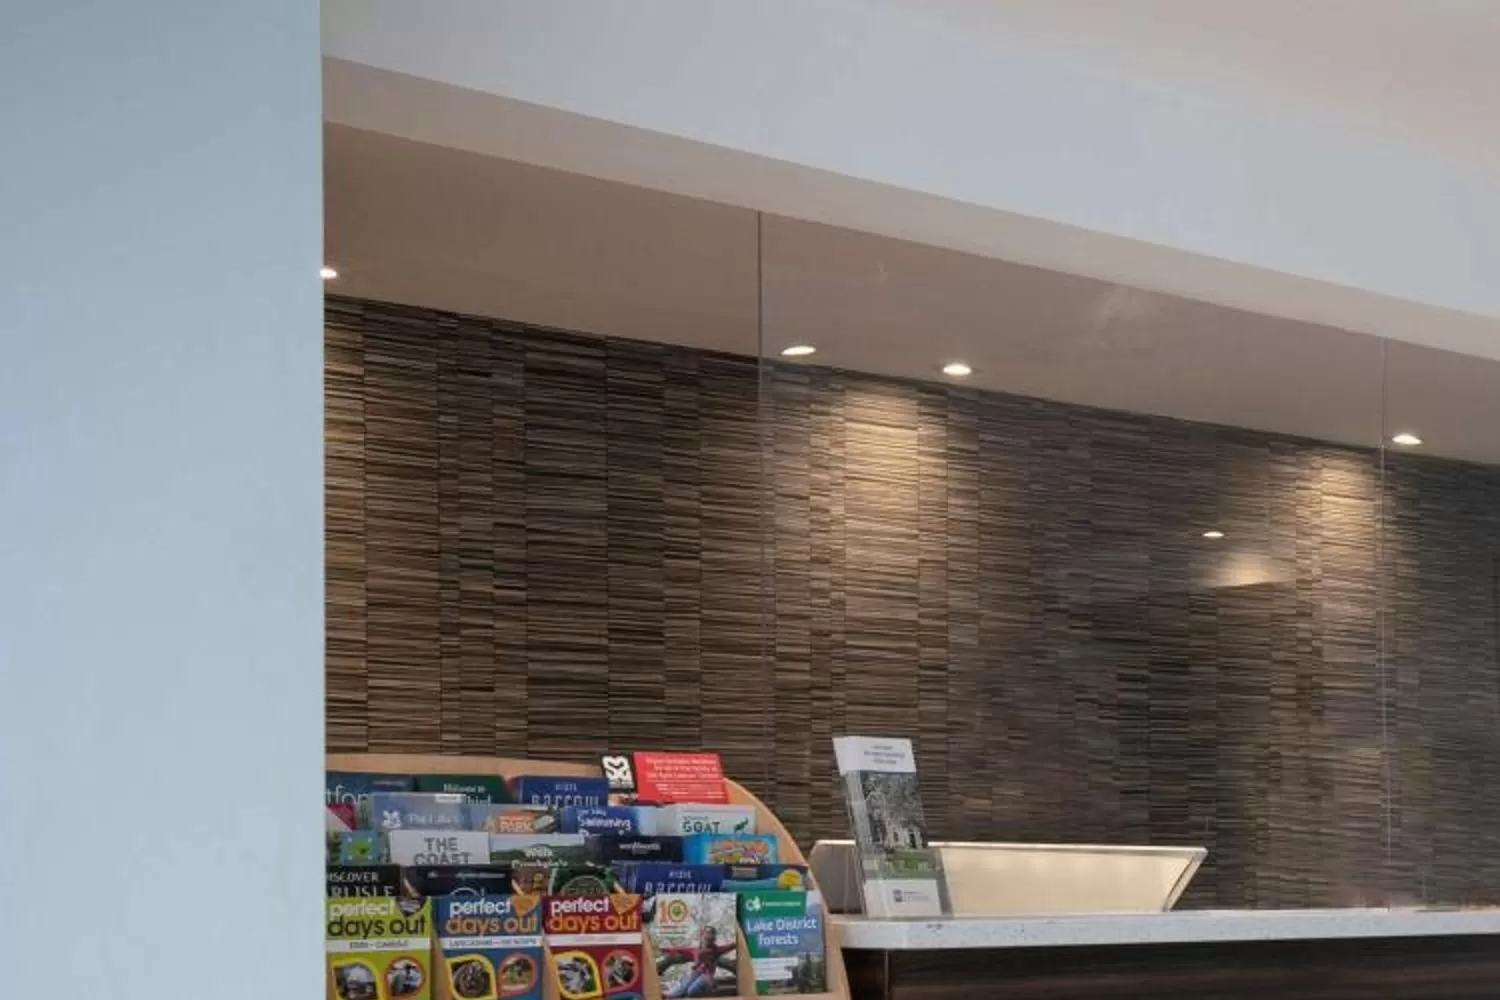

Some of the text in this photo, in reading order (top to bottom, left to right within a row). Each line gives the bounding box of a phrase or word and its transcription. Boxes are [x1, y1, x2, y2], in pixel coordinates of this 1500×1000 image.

[682, 820, 720, 833] GOAT
[424, 836, 459, 851] THE
[413, 853, 471, 865] COAST
[328, 871, 380, 883] ISCOVER
[328, 900, 395, 918] perfect
[450, 897, 512, 916] perfect
[551, 896, 610, 916] perfect
[327, 916, 426, 938] days out
[445, 915, 538, 936] days out
[550, 914, 601, 934] days
[604, 914, 639, 931] out
[746, 917, 818, 933] Lake District
